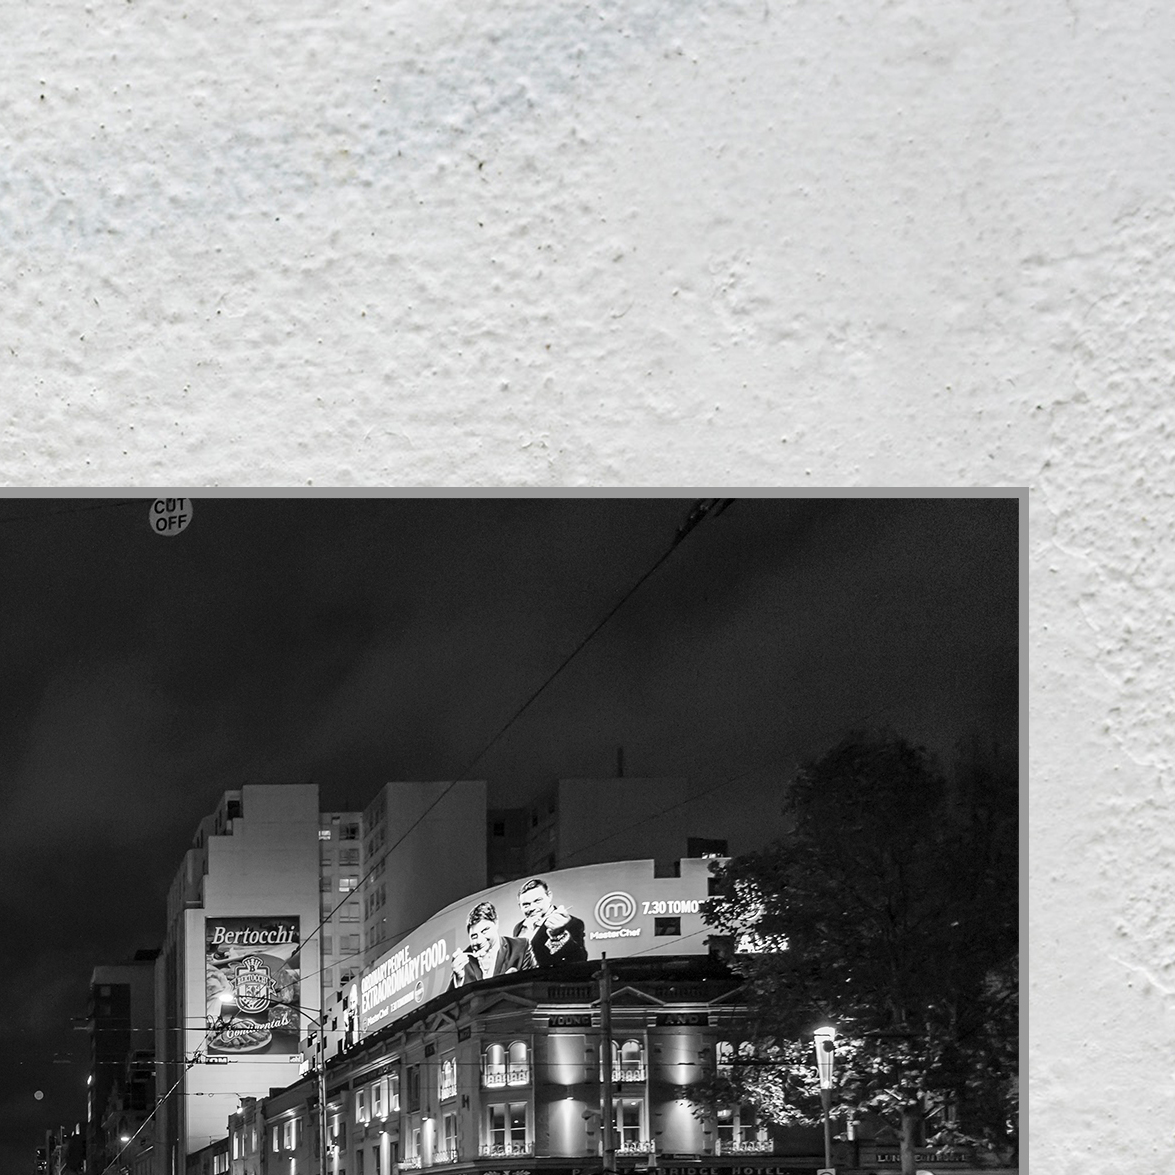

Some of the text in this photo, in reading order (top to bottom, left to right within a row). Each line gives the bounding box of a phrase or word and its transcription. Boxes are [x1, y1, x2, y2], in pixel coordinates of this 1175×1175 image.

[153, 498, 187, 514] CUT
[155, 514, 188, 532] OFF
[641, 900, 667, 915] 7.30
[211, 924, 296, 945] Bertocchi
[589, 927, 642, 941] MasterChef
[361, 955, 420, 1014] EXTRAORDINARY
[420, 938, 451, 976] FOOD.
[550, 1015, 589, 1026] YOUNG
[664, 1013, 700, 1025] AND
[658, 1167, 719, 1175] BRIDGE
[731, 1166, 791, 1175] HOTEL.
